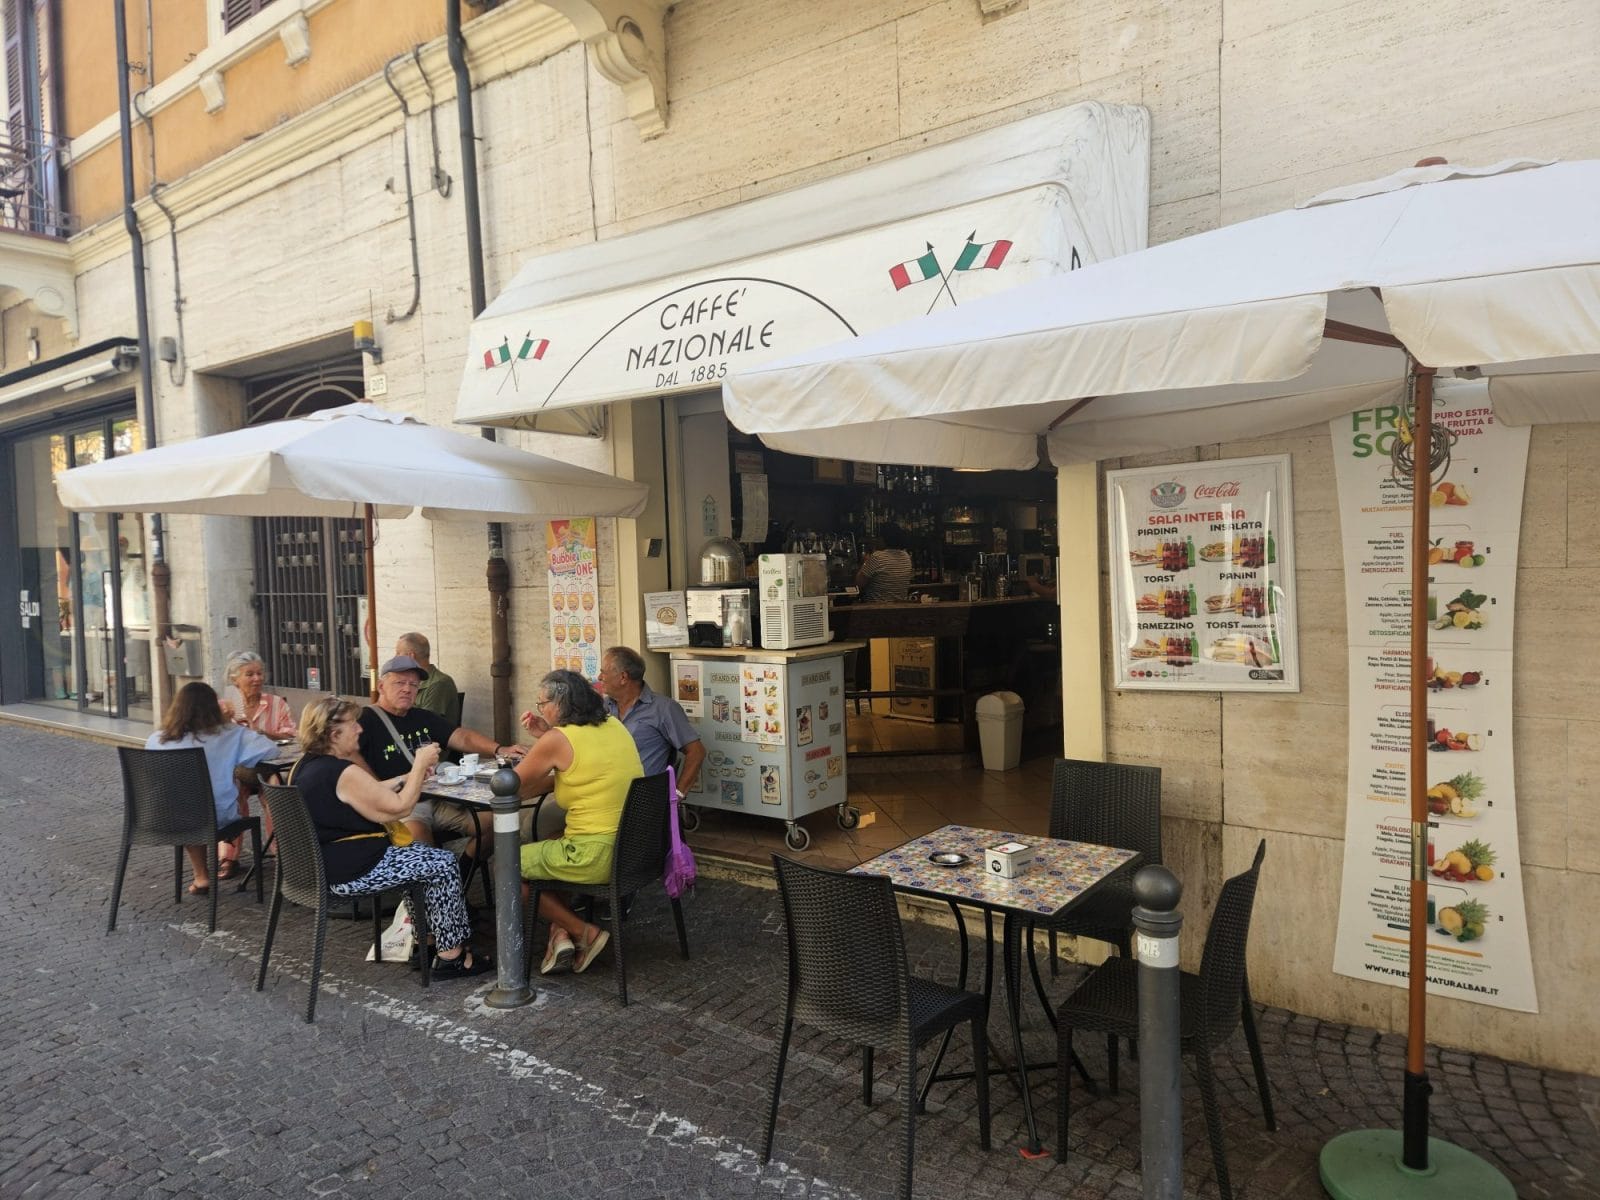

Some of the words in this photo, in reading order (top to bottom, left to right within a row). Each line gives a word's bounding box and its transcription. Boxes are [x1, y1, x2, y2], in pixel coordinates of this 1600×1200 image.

[626, 320, 775, 371] NAZIONALE
[656, 371, 679, 388] DAL
[691, 363, 728, 383] 1885
[1435, 410, 1462, 420] PURO
[1447, 418, 1486, 428] FRUTTA
[1487, 417, 1494, 425] E
[1194, 481, 1241, 499] Coca-Cola
[1148, 513, 1181, 525] SALA
[1137, 527, 1178, 536] PIADINA
[551, 552, 578, 565] Bubble
[576, 562, 593, 576] ONE
[1220, 572, 1257, 580] PANINI
[1137, 622, 1195, 630] RAMEZZINO
[1206, 621, 1240, 629] TOAST
[1377, 914, 1410, 924] RIGENERAN
